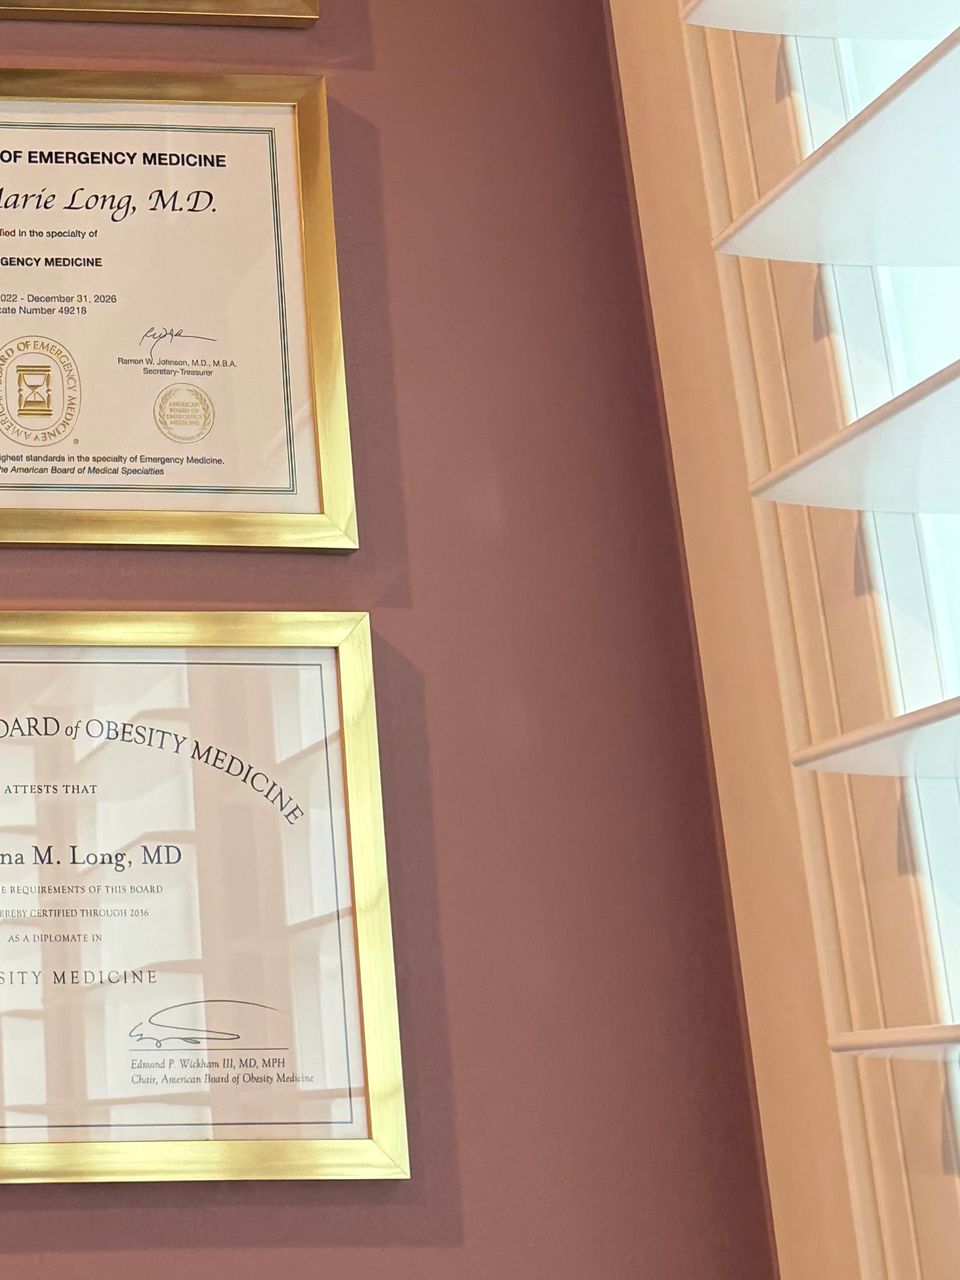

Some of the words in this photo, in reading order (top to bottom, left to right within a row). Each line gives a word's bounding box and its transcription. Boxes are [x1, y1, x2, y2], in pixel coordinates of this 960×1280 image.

[0, 149, 23, 164] OF
[27, 150, 138, 165] EMERGENCY
[142, 152, 227, 168] MEDICINE
[63, 187, 137, 223] Long,
[148, 188, 217, 213] M.D.
[19, 228, 27, 237] in
[29, 229, 44, 238] the
[46, 229, 86, 240] specialty
[88, 229, 98, 238] of
[44, 257, 103, 267] MEDICINE
[27, 294, 74, 304] December
[94, 295, 117, 304] 2026
[19, 306, 56, 315] Number
[58, 306, 87, 315] 49218
[117, 357, 144, 365] Ramon
[156, 358, 190, 367] Johnson,
[213, 359, 237, 368] M.B.A.
[143, 367, 213, 377] Secretary-Treasurer
[26, 454, 65, 463] standards
[67, 455, 75, 463] in
[77, 455, 90, 463] the
[92, 455, 127, 464] specialty
[129, 455, 138, 463] of
[140, 455, 184, 466] Emergency
[186, 456, 225, 465] Medicine.
[64, 720, 82, 741] of
[85, 718, 187, 755] OBESITY
[190, 739, 305, 825] MEDICINE
[4, 784, 58, 794] ATTESTS
[62, 784, 98, 795] THAT
[32, 845, 61, 865] M.
[69, 845, 133, 872] Long,
[141, 845, 182, 865] MD
[10, 885, 86, 894] REQUIREMENTS
[88, 885, 101, 894] OF
[105, 885, 127, 894] THIS
[130, 885, 164, 894] BOARD
[53, 970, 157, 984] MEDICINE
